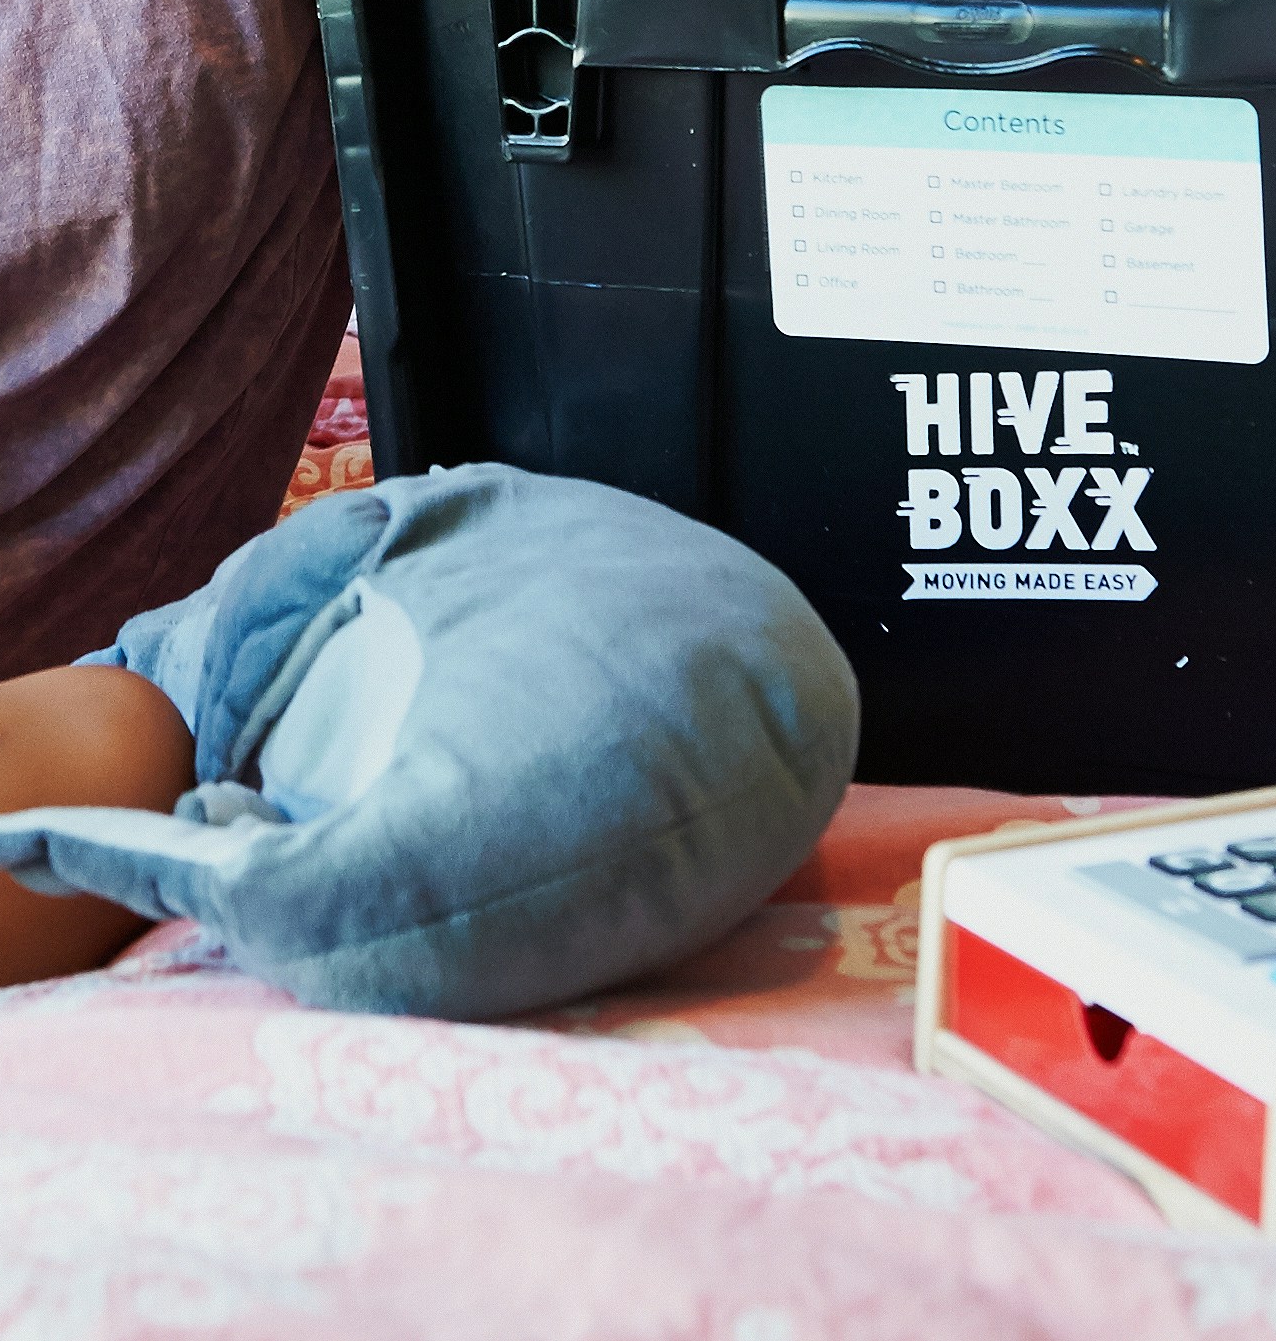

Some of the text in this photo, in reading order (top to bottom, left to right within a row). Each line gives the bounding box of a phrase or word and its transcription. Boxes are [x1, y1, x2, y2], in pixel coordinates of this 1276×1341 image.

[943, 109, 1066, 136] Contents
[813, 173, 863, 184] Kitchen
[950, 178, 1063, 192] Master Bedroom
[1122, 187, 1225, 201] Laundry Room
[814, 207, 901, 221] Dining Room
[952, 213, 1070, 229] Master Bathroom
[1124, 221, 1174, 236] Garage
[817, 242, 901, 256] Living Room
[955, 247, 1019, 261] Bedroom
[1126, 257, 1195, 272] Basement
[818, 276, 859, 289] Office
[957, 282, 1025, 297] Bathroom
[889, 369, 1114, 456] HIVE
[896, 467, 1158, 552] BOXX
[924, 573, 1137, 591] MOVING MADE EASY
